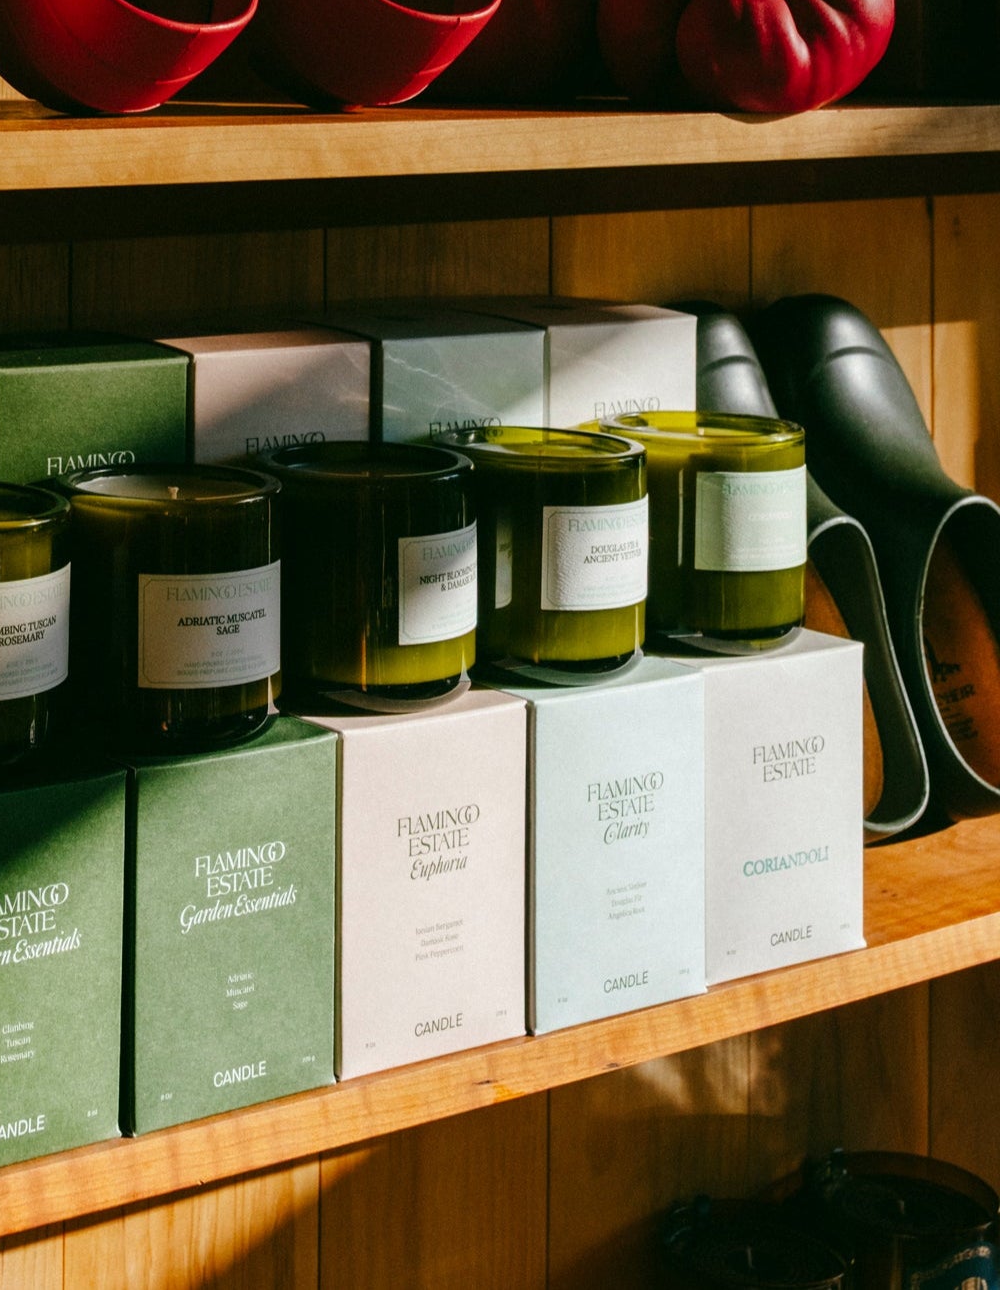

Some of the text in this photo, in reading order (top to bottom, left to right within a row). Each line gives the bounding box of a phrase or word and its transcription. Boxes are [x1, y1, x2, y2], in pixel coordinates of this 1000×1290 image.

[584, 554, 619, 564] ANCIENT
[591, 541, 626, 554] DOUGLAS
[419, 572, 446, 585] NIGHT
[441, 583, 447, 592] &
[27, 615, 57, 631] TUSCAN
[177, 608, 267, 627] ADRIATIC MUSCATEL
[216, 625, 240, 636] SAGE
[753, 734, 825, 765] FLAMINGO
[763, 756, 816, 783] ESTATE
[587, 770, 665, 803] FLAMINGO
[397, 803, 480, 838] FLAMINGO
[598, 794, 655, 822] ESTATE
[408, 828, 470, 857] ESTATE
[603, 819, 651, 846] Clarity
[195, 840, 286, 878] FLAMINGO
[410, 851, 469, 882] Euphoria
[743, 846, 829, 878] CORIANDOLI
[206, 865, 274, 898] ESTATE
[180, 883, 298, 935] Garden Essentials
[13, 927, 82, 963] Essentials
[770, 925, 813, 947] CANDLE
[603, 970, 649, 994] CANDLE
[232, 999, 249, 1011] Sage
[414, 1013, 463, 1038] CANDLE
[5, 1035, 31, 1048] Tuscan
[0, 1048, 36, 1064] Rosemary
[213, 1060, 267, 1088] CANDLE
